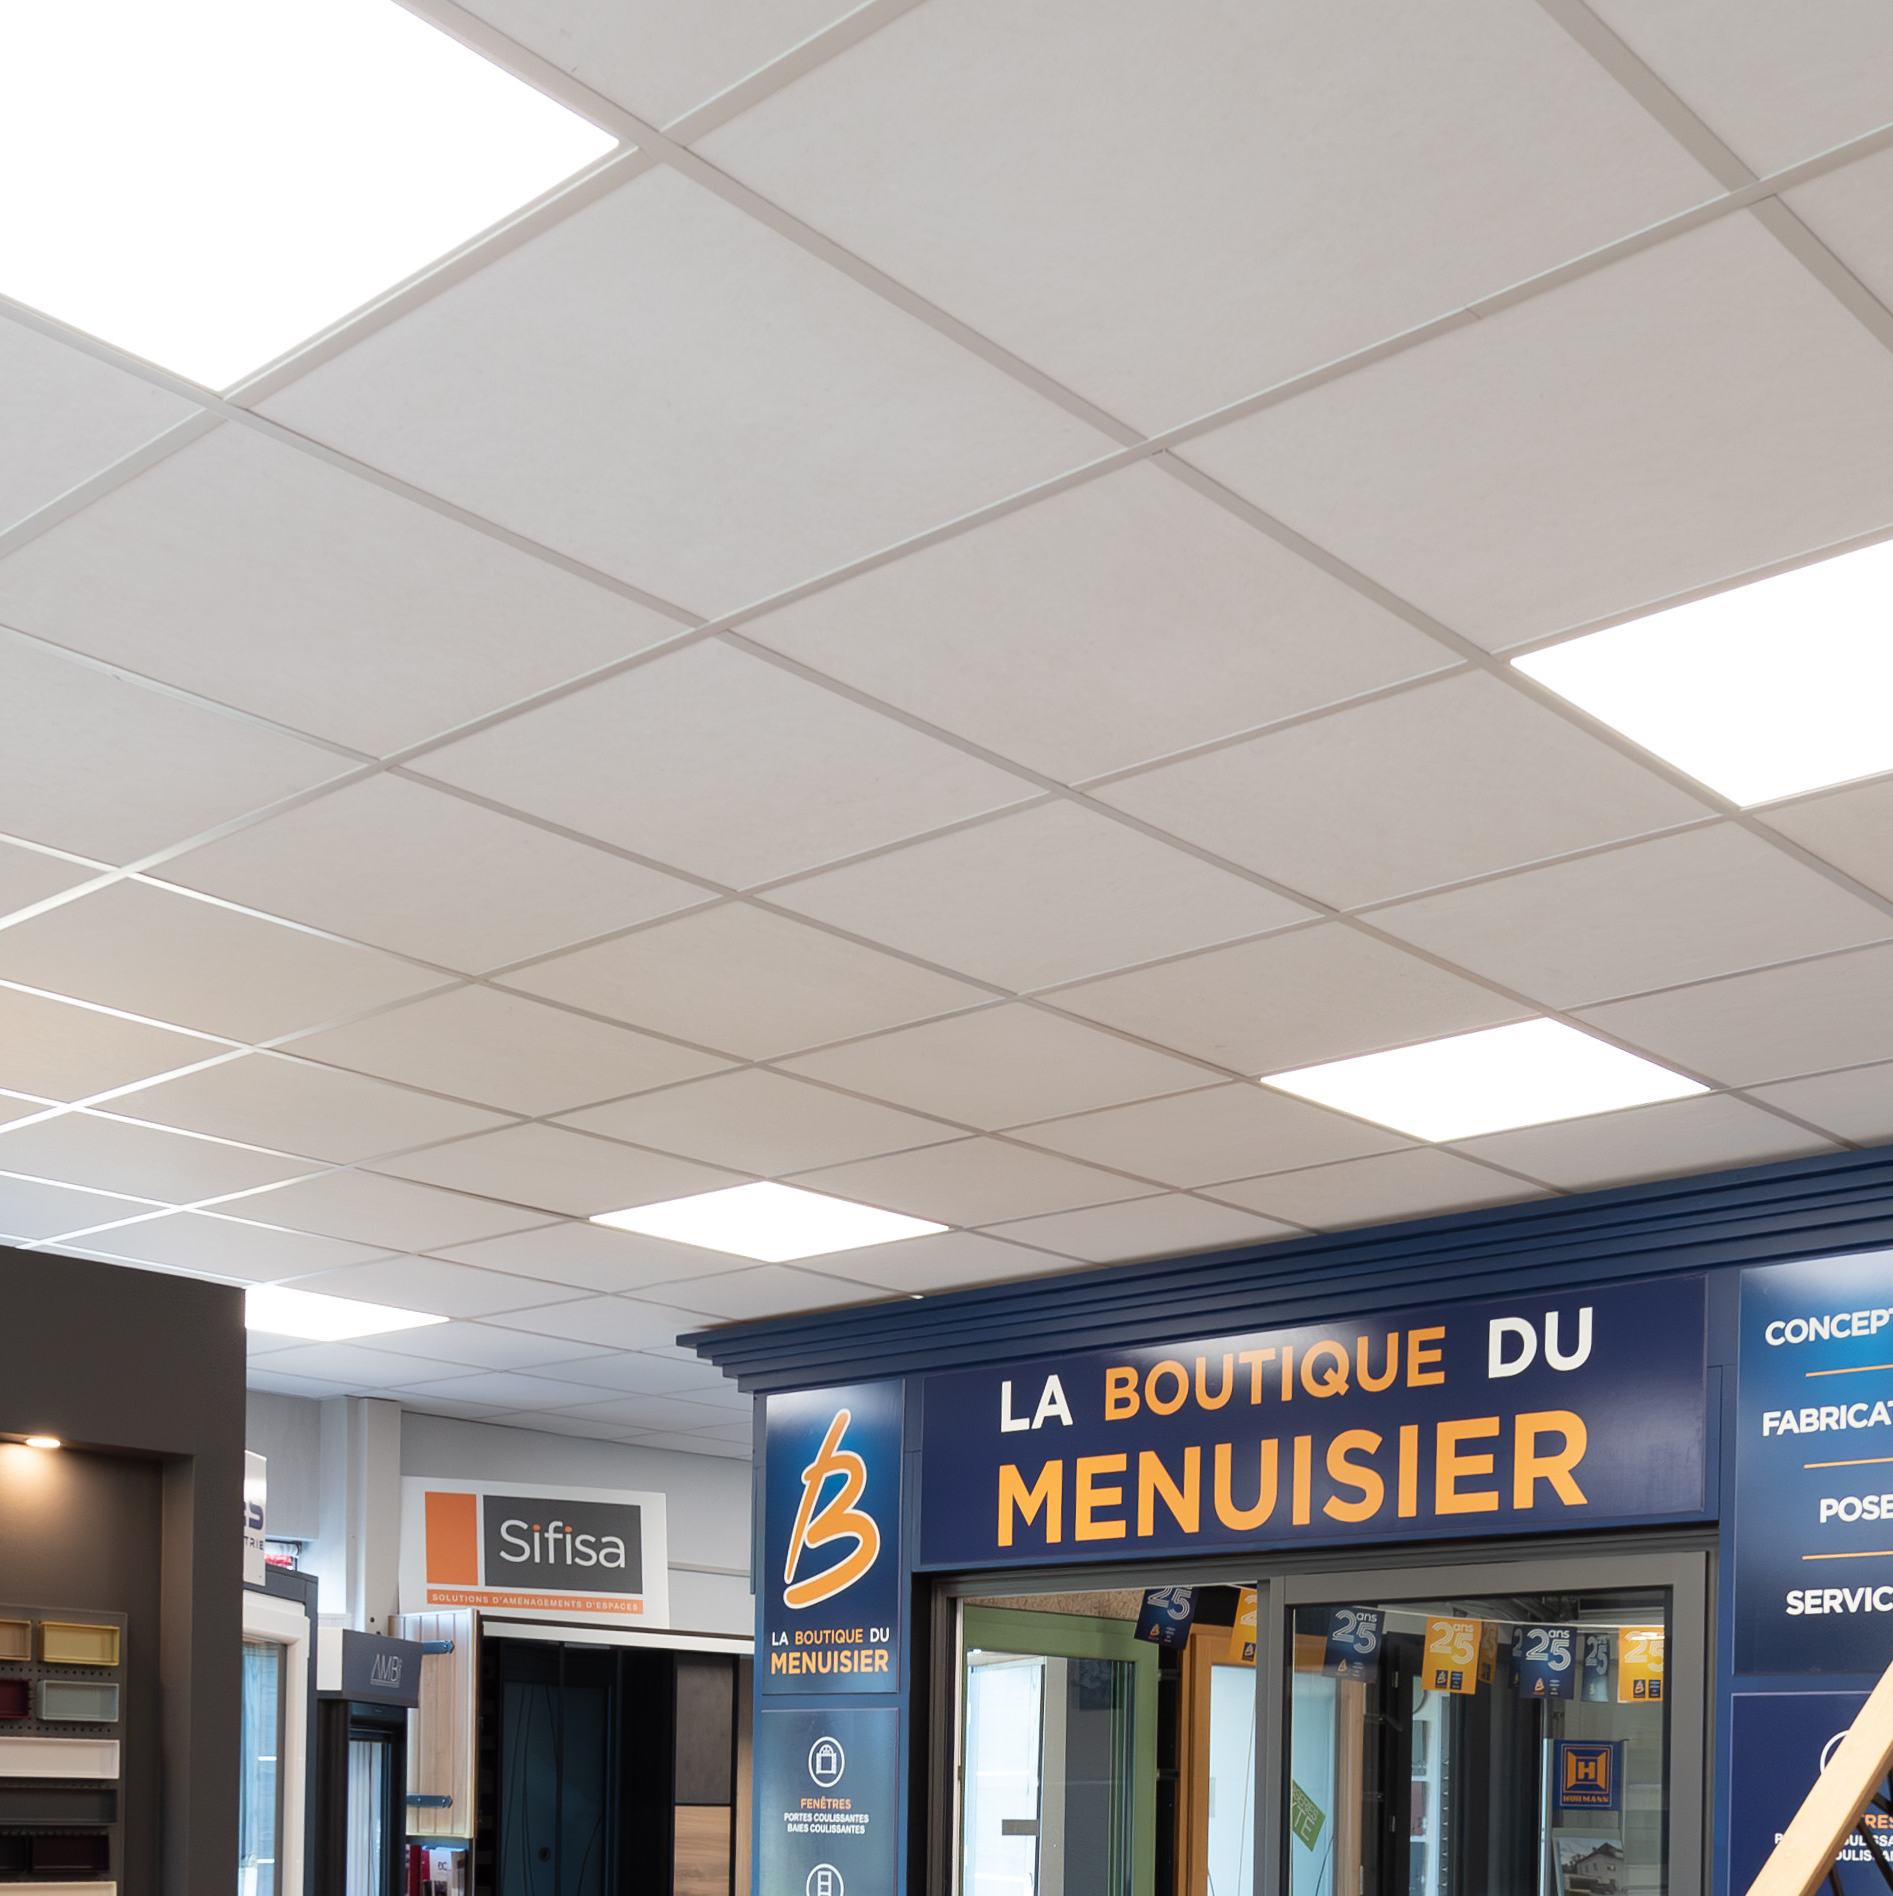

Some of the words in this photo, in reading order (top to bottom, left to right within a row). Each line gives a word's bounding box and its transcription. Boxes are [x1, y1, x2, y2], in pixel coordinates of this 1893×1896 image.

[1000, 1374, 1073, 1433] LA
[1104, 1325, 1446, 1421] BOUTIQUE
[1489, 1306, 1593, 1379] DU
[997, 1409, 1588, 1547] MENUISIER
[783, 1408, 880, 1610] B
[499, 1518, 626, 1568] Sifisa
[432, 1592, 488, 1604] SOLUTIONS
[586, 1601, 638, 1612] D'ESPACES
[772, 1631, 789, 1646] LA
[795, 1628, 863, 1645] BOUTIQUE
[870, 1627, 889, 1643] DU
[1331, 1609, 1376, 1654] 25
[1356, 1611, 1377, 1623] ans
[1429, 1621, 1475, 1665] 25
[1453, 1623, 1474, 1633] ans
[1548, 1629, 1570, 1639] ans
[771, 1649, 888, 1675] MENUISIER
[1525, 1628, 1572, 1672] 25
[1578, 1761, 1596, 1780] H
[801, 1796, 851, 1810] FENÊTRES
[784, 1813, 813, 1823] PORTES
[814, 1813, 869, 1824] COULISSANTES
[787, 1823, 809, 1834] BAIES
[810, 1824, 865, 1835] COULISSANTES
